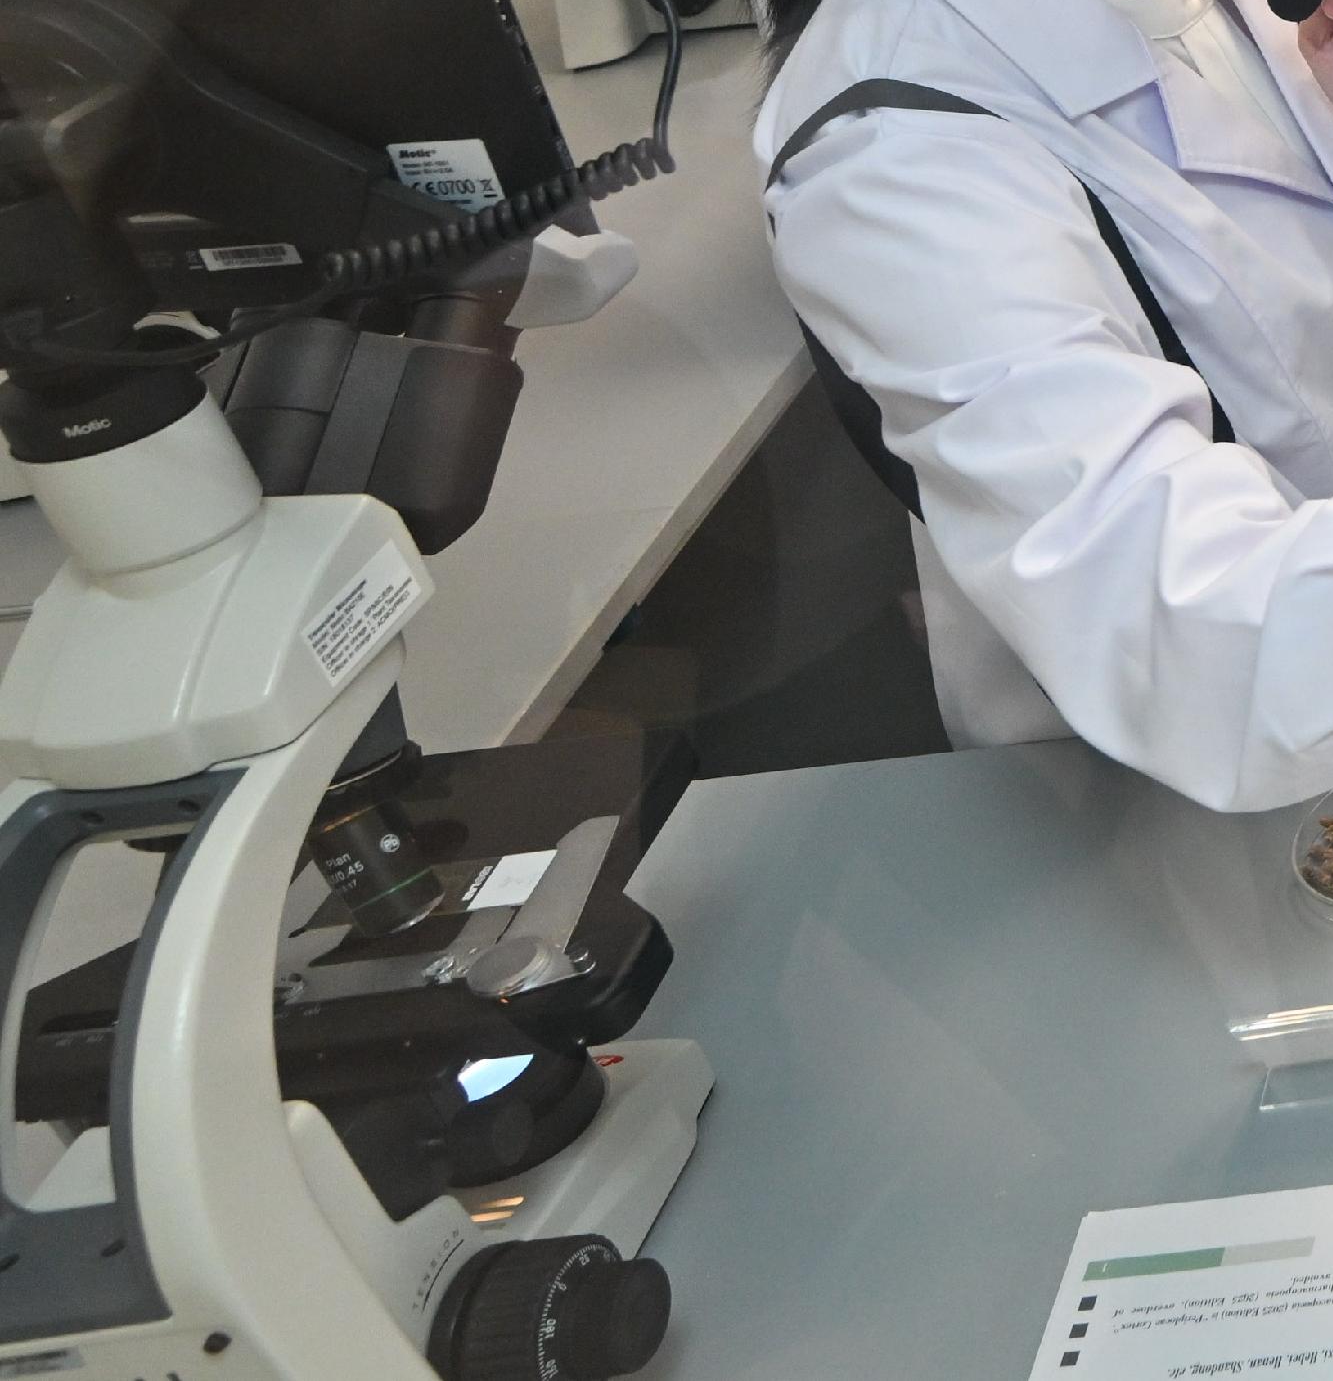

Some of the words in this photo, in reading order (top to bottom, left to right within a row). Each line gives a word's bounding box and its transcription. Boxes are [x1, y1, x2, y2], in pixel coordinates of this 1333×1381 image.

[438, 179, 475, 196] 0700
[62, 418, 112, 438] Motic
[1167, 1365, 1186, 1379] etc.
[1189, 1360, 1243, 1377] Shandong,
